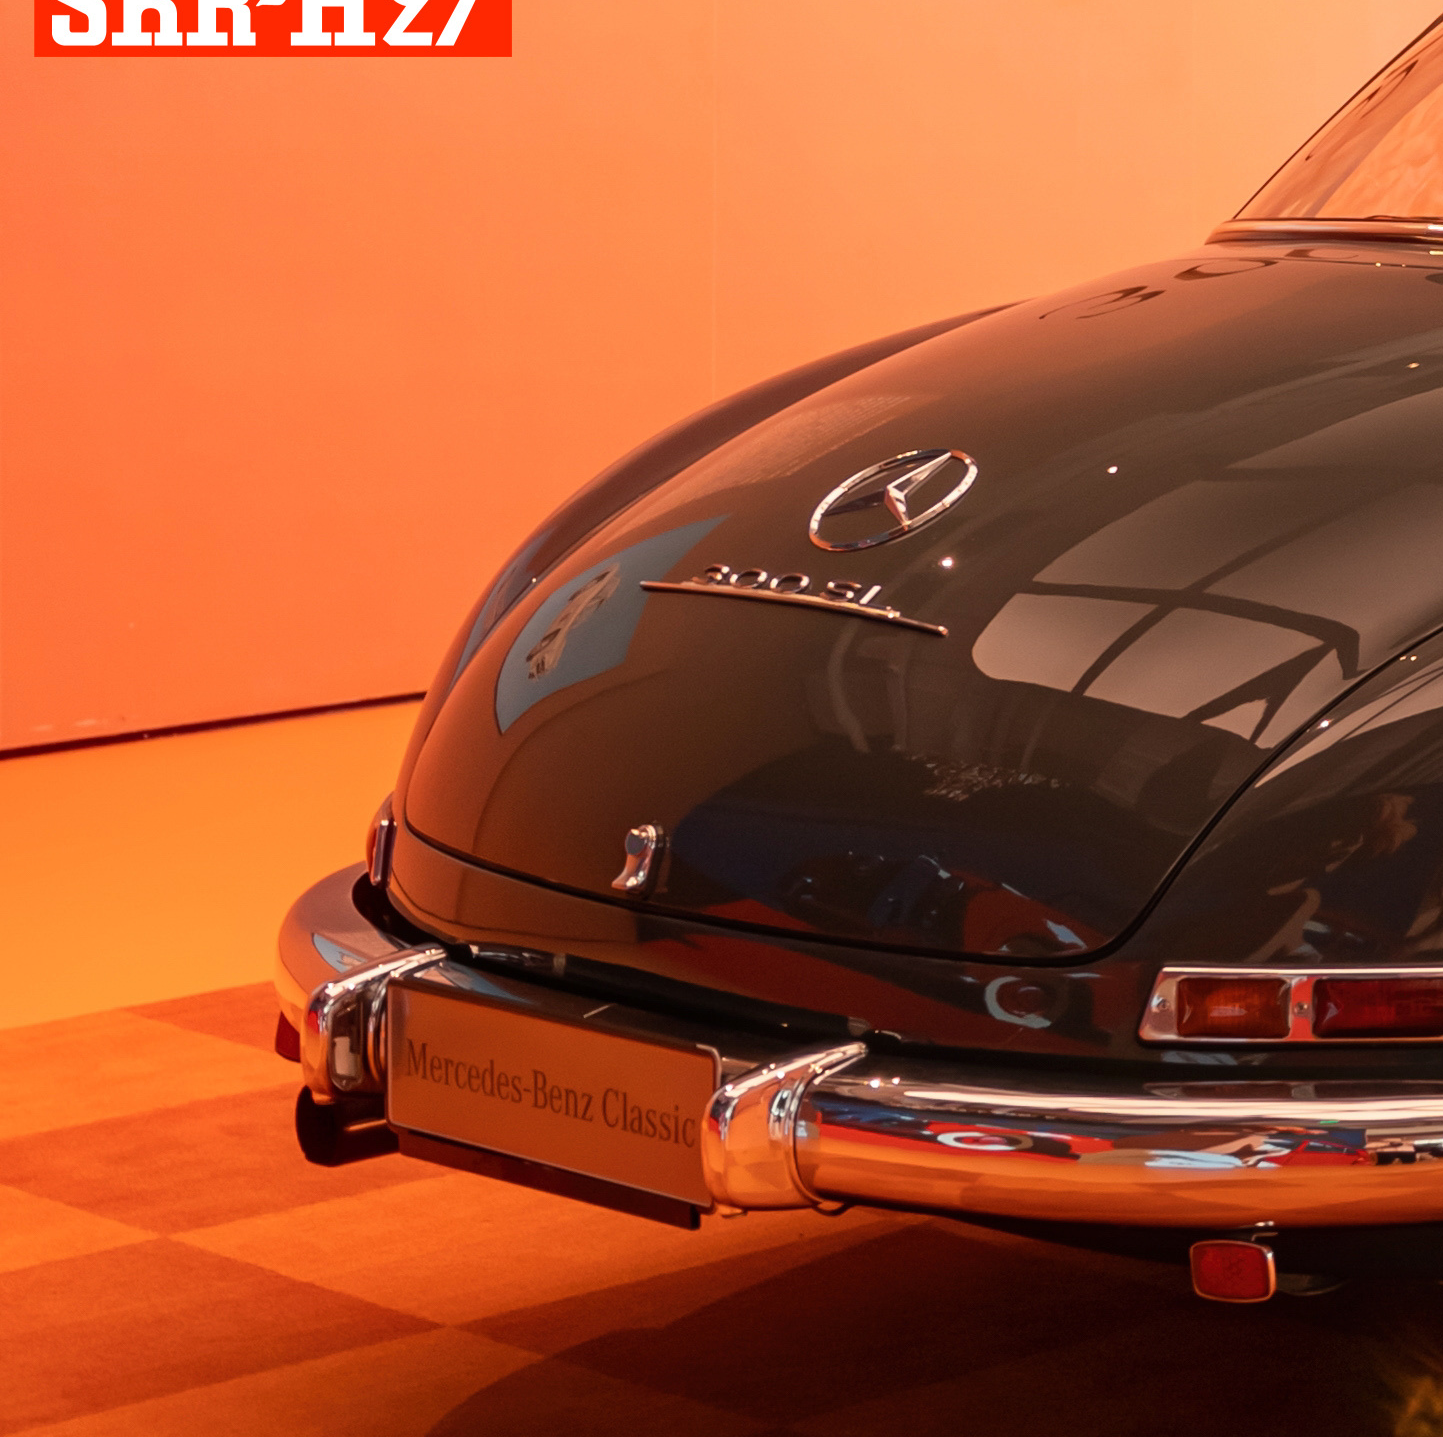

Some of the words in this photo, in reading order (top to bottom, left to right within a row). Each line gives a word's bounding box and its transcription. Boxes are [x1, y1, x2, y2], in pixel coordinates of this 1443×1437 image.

[692, 563, 811, 595] 300
[820, 580, 900, 618] SL
[406, 1038, 594, 1123] Mercedes-Benz
[602, 1087, 697, 1149] Classic
